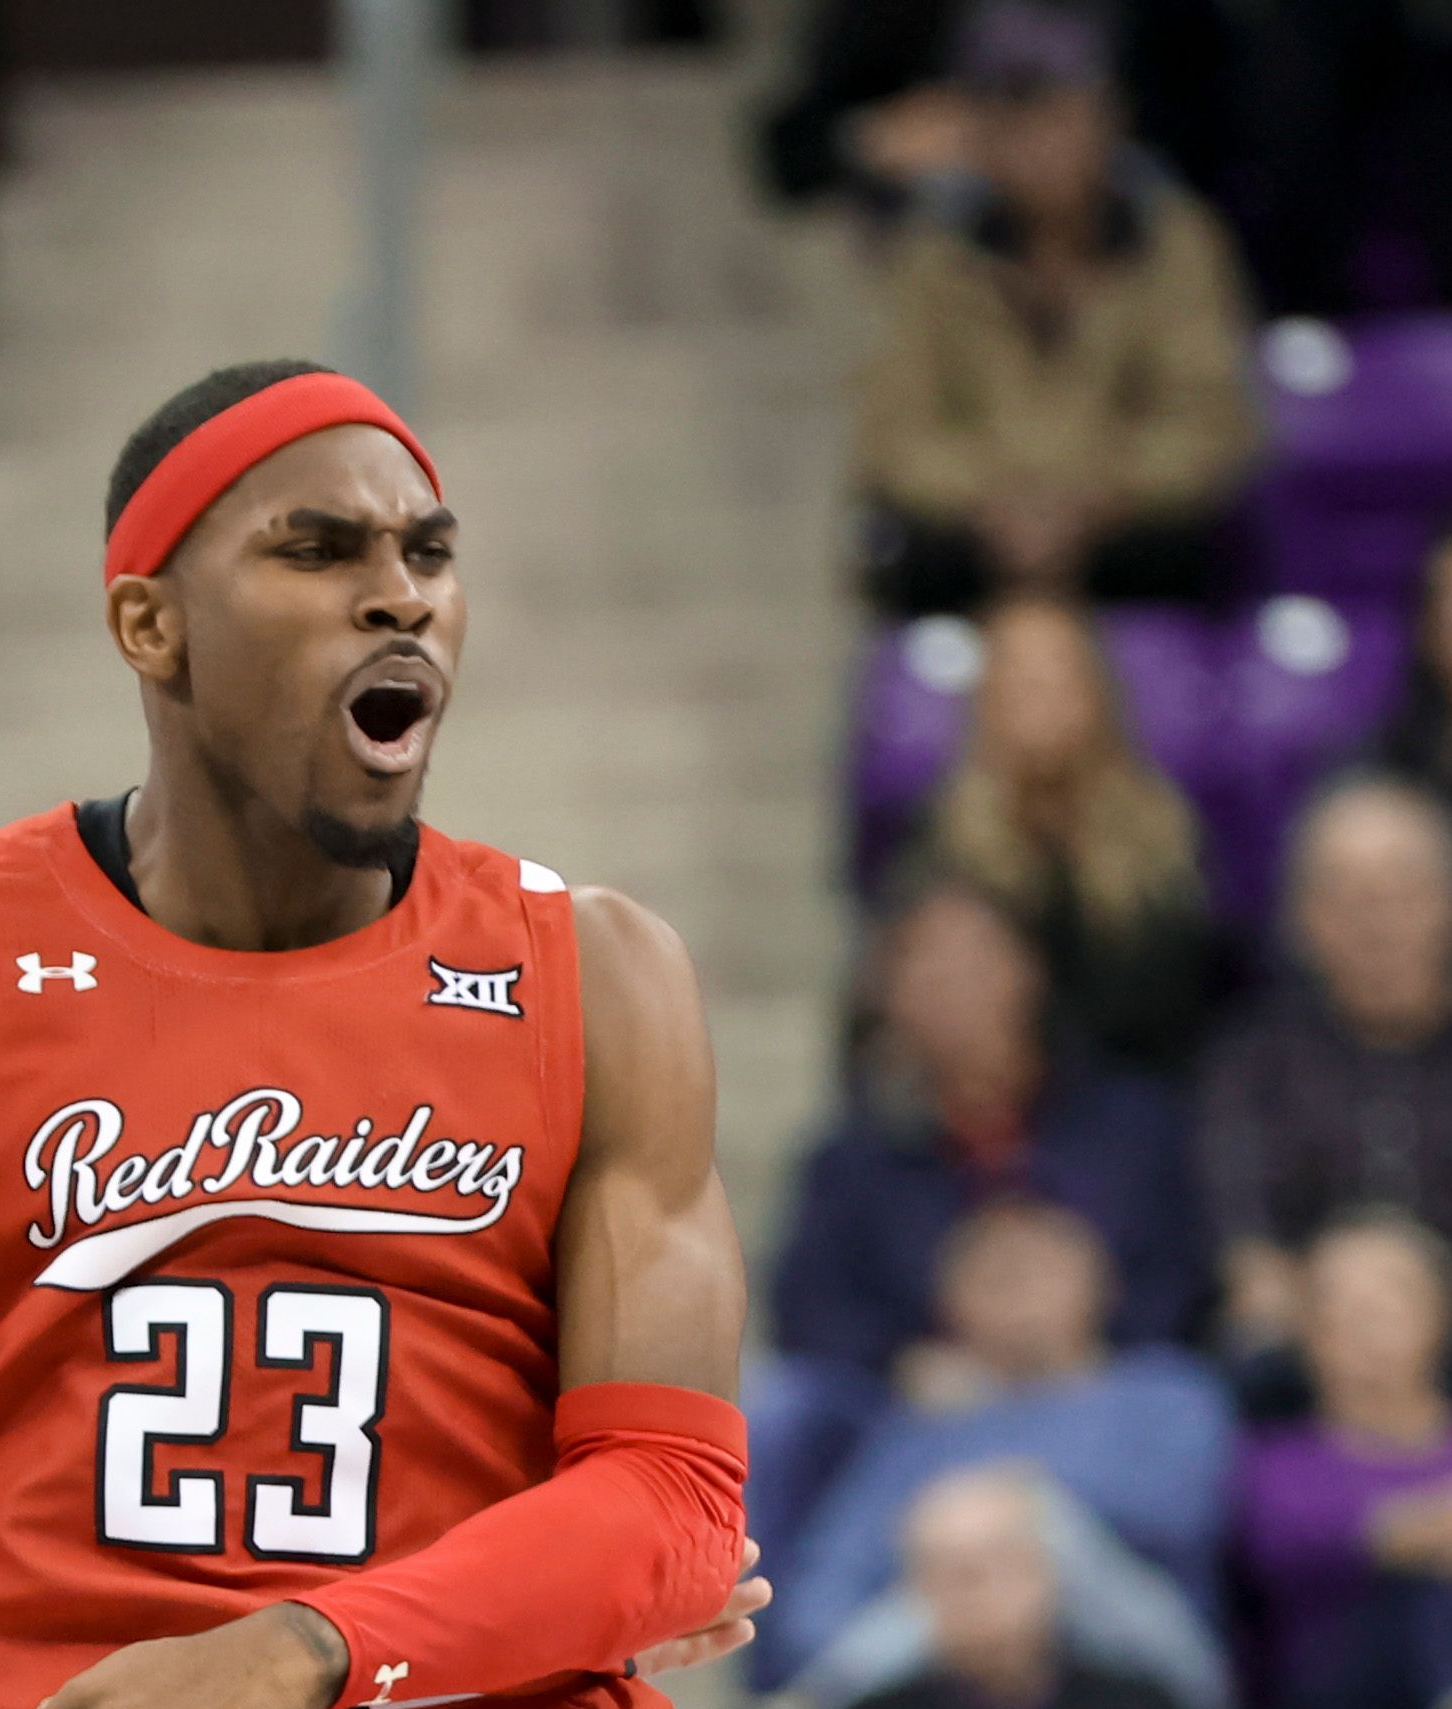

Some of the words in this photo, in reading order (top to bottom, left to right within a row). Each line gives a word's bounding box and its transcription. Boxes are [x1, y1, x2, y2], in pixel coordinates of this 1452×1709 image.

[428, 955, 525, 1020] XII
[24, 1097, 214, 1249] Red
[200, 1087, 524, 1201] Raiders
[98, 1277, 391, 1564] 23
